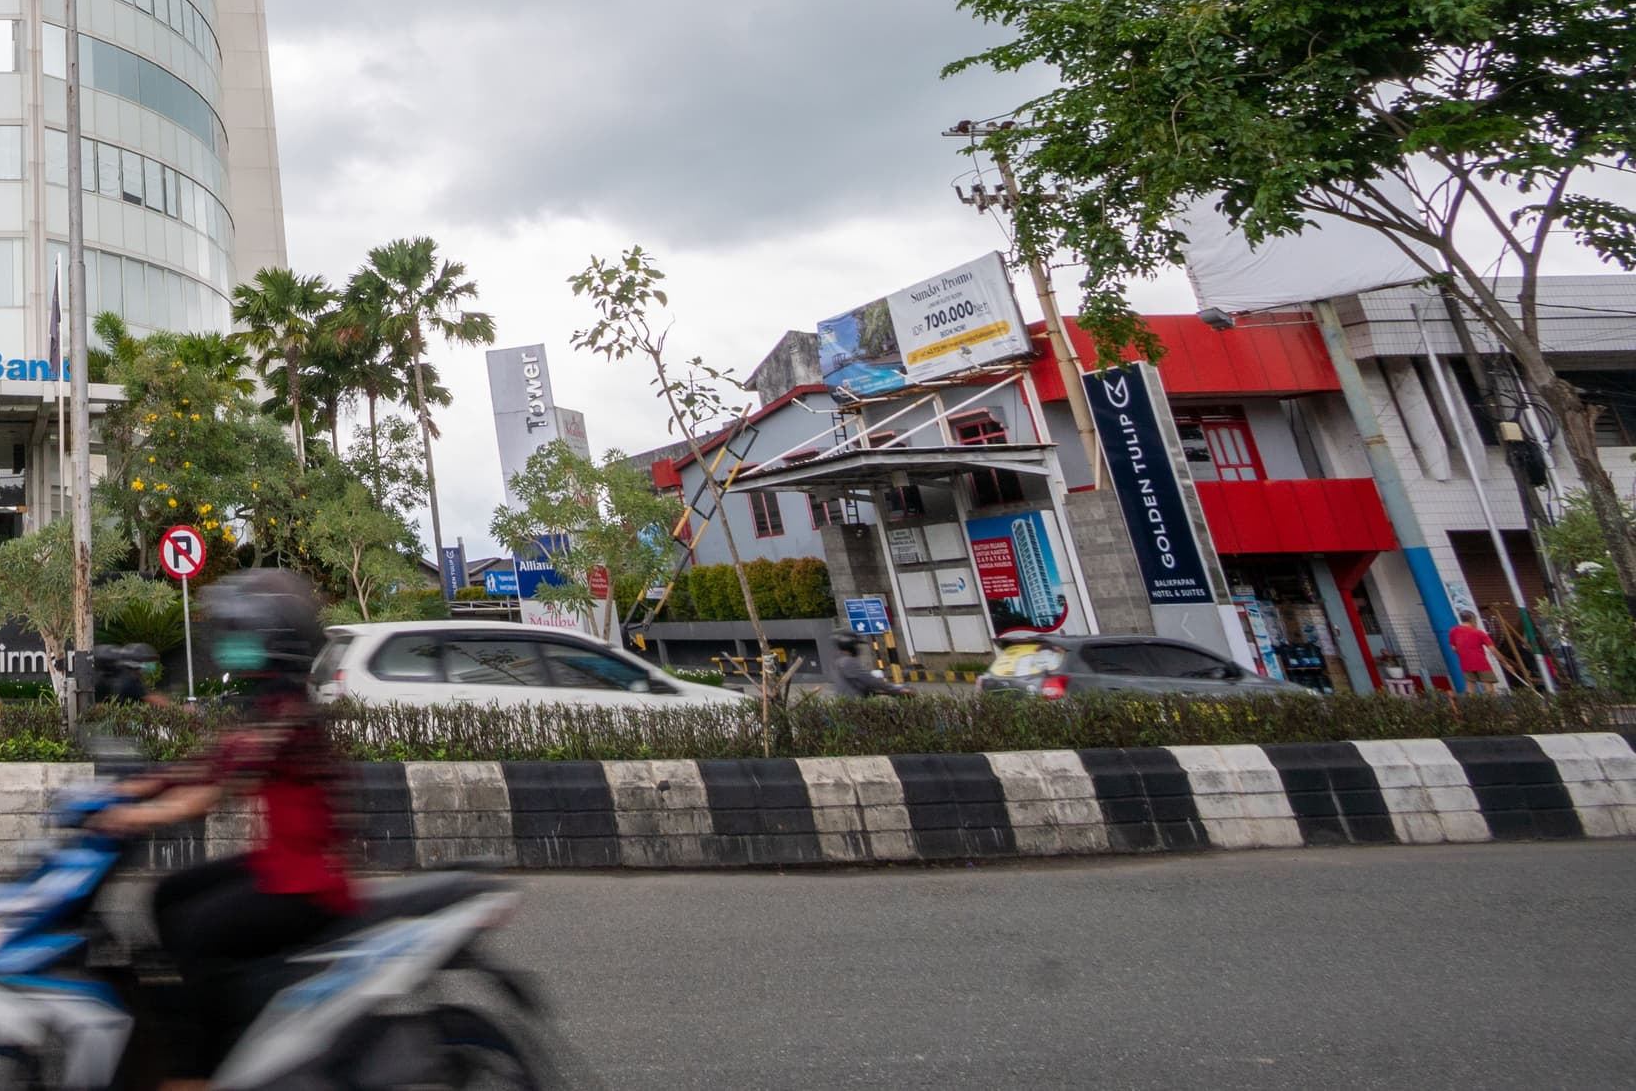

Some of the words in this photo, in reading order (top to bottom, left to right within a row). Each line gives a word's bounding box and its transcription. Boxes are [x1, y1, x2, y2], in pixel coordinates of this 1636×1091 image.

[910, 284, 940, 304] Sunday
[941, 272, 974, 291] Promo
[924, 300, 974, 331] 700.000
[521, 353, 548, 434] Tower
[1119, 413, 1147, 474] TULIP
[1138, 479, 1176, 569] GOLDEN
[1152, 589, 1174, 598] HOTEL
[1180, 588, 1206, 597] SUITES
[1154, 577, 1196, 588] BALIKPAPAN
